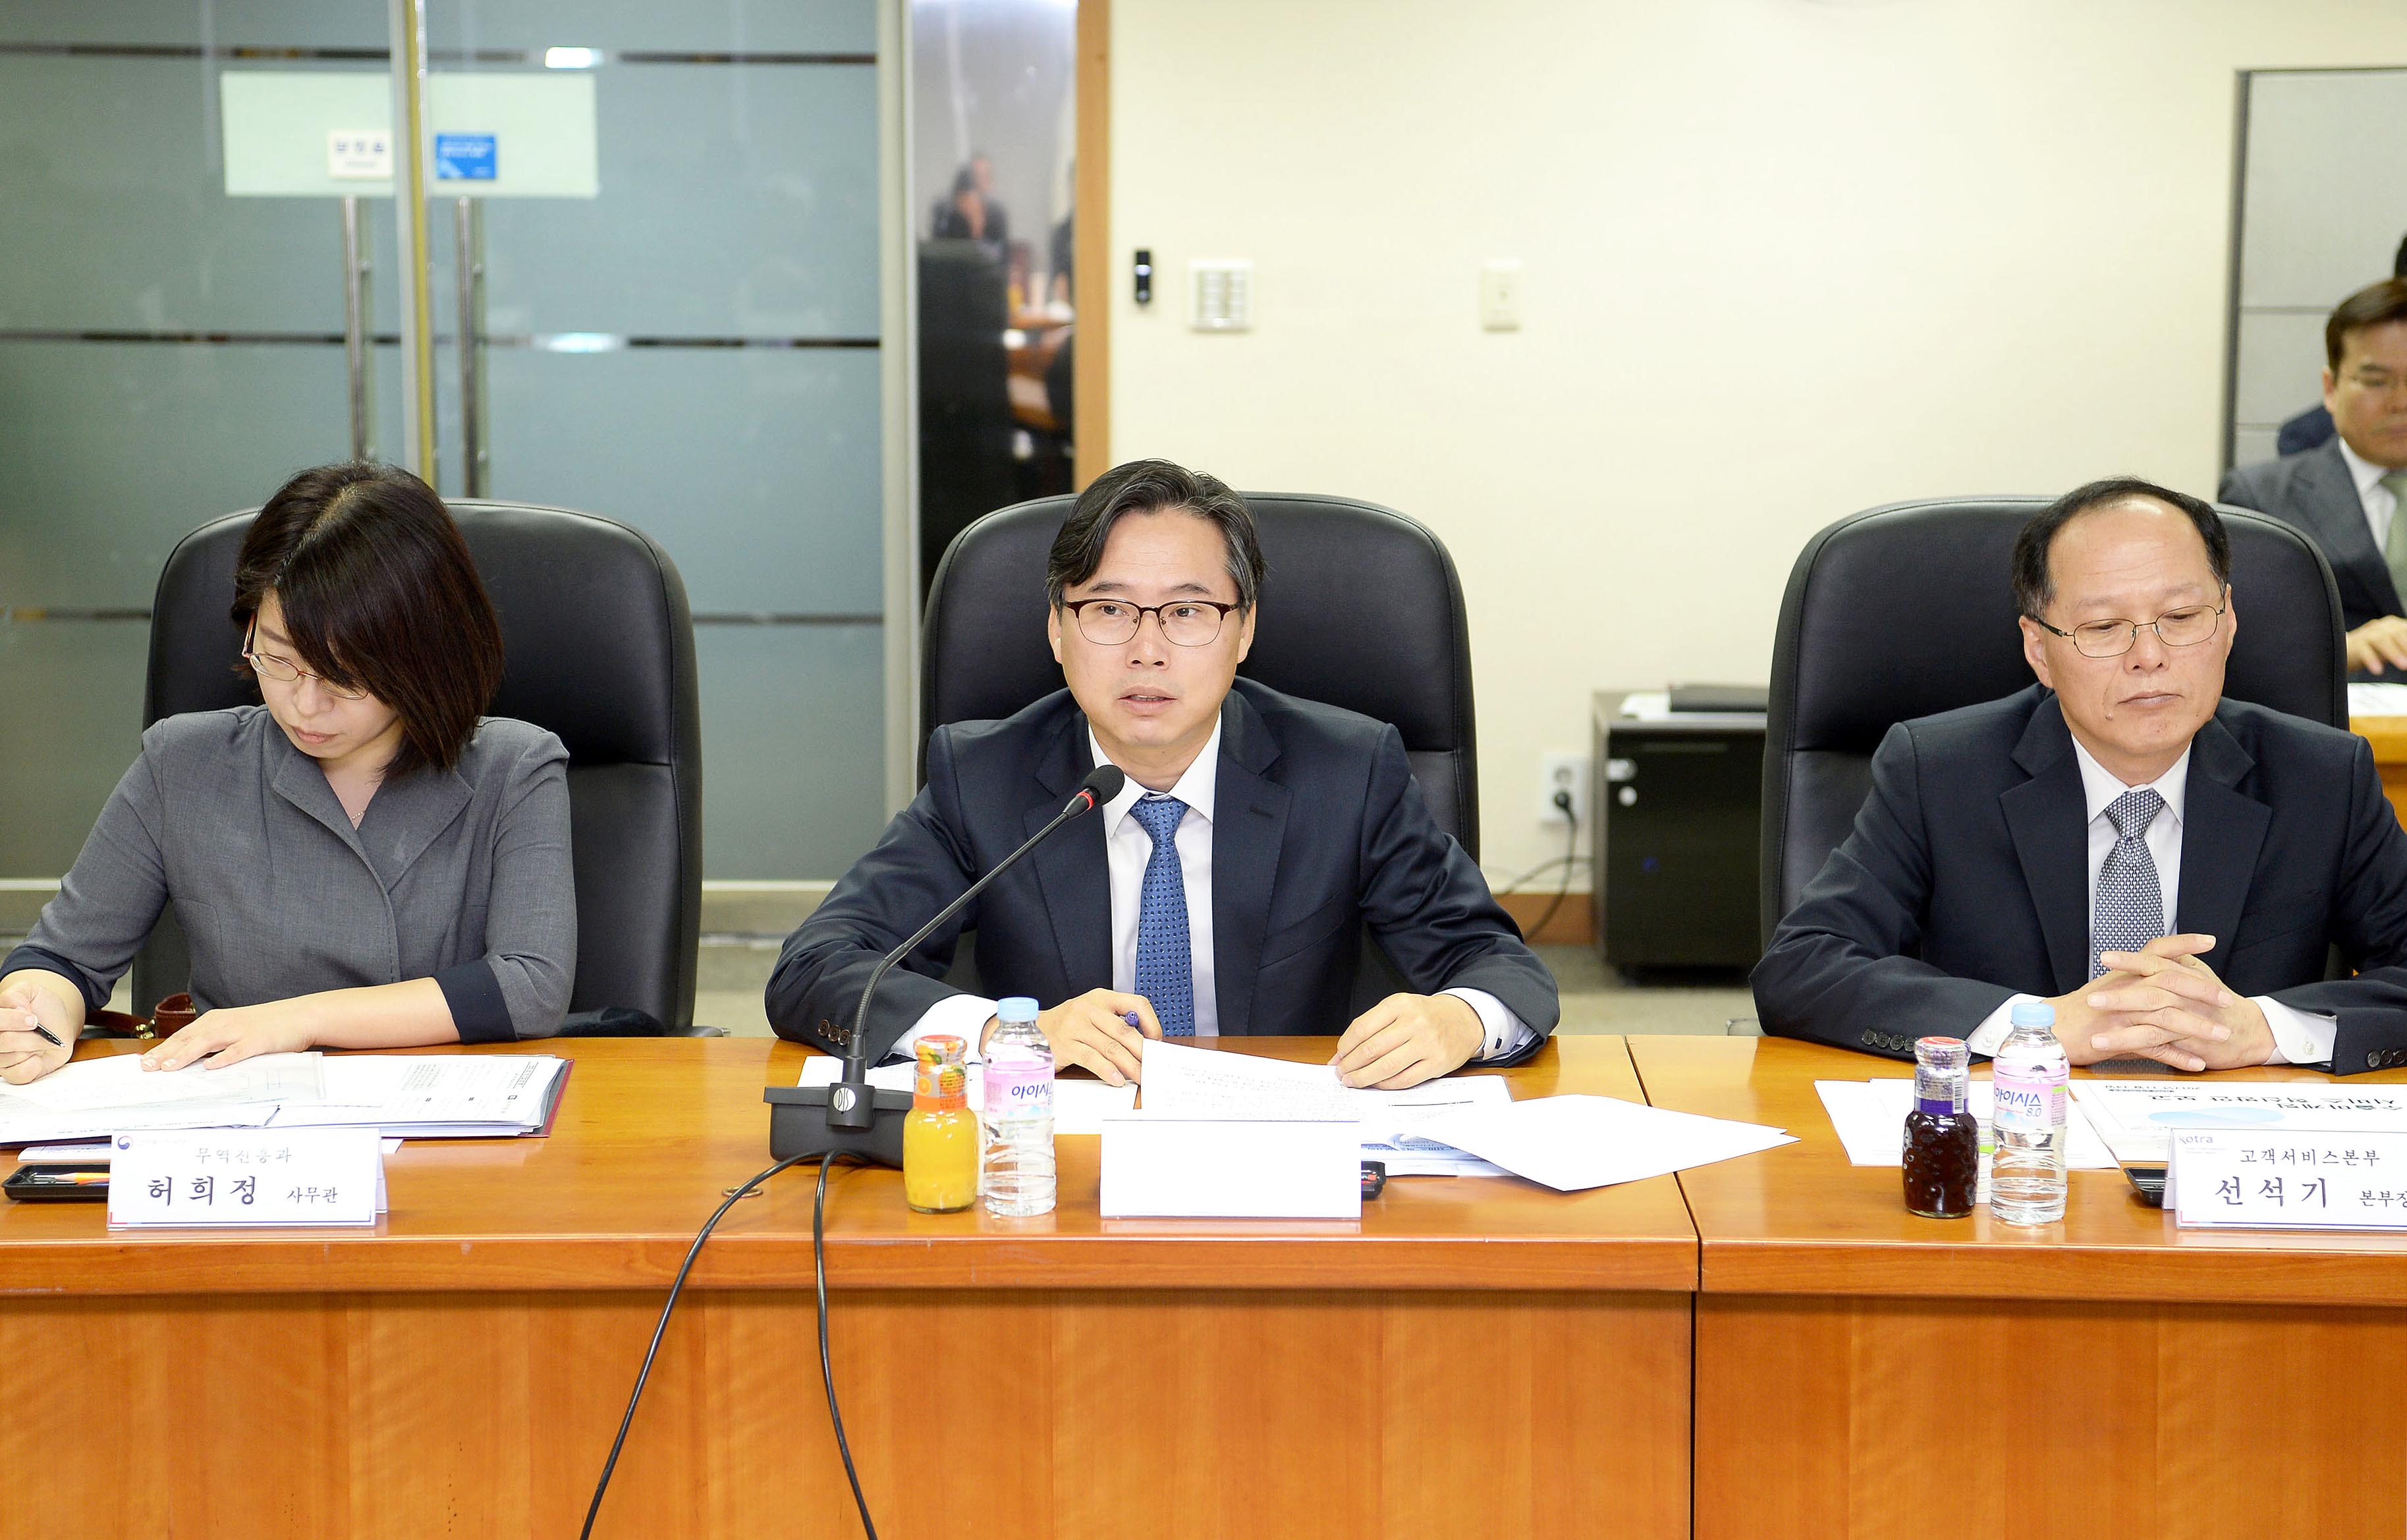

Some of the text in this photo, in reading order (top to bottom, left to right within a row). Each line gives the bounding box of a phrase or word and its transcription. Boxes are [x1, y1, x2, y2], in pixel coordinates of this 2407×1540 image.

[2026, 1107, 2042, 1117] 8.0
[2178, 1134, 2213, 1145] kotra
[2240, 1148, 2381, 1167] 고객서비스본부
[286, 1186, 339, 1204] 사무관
